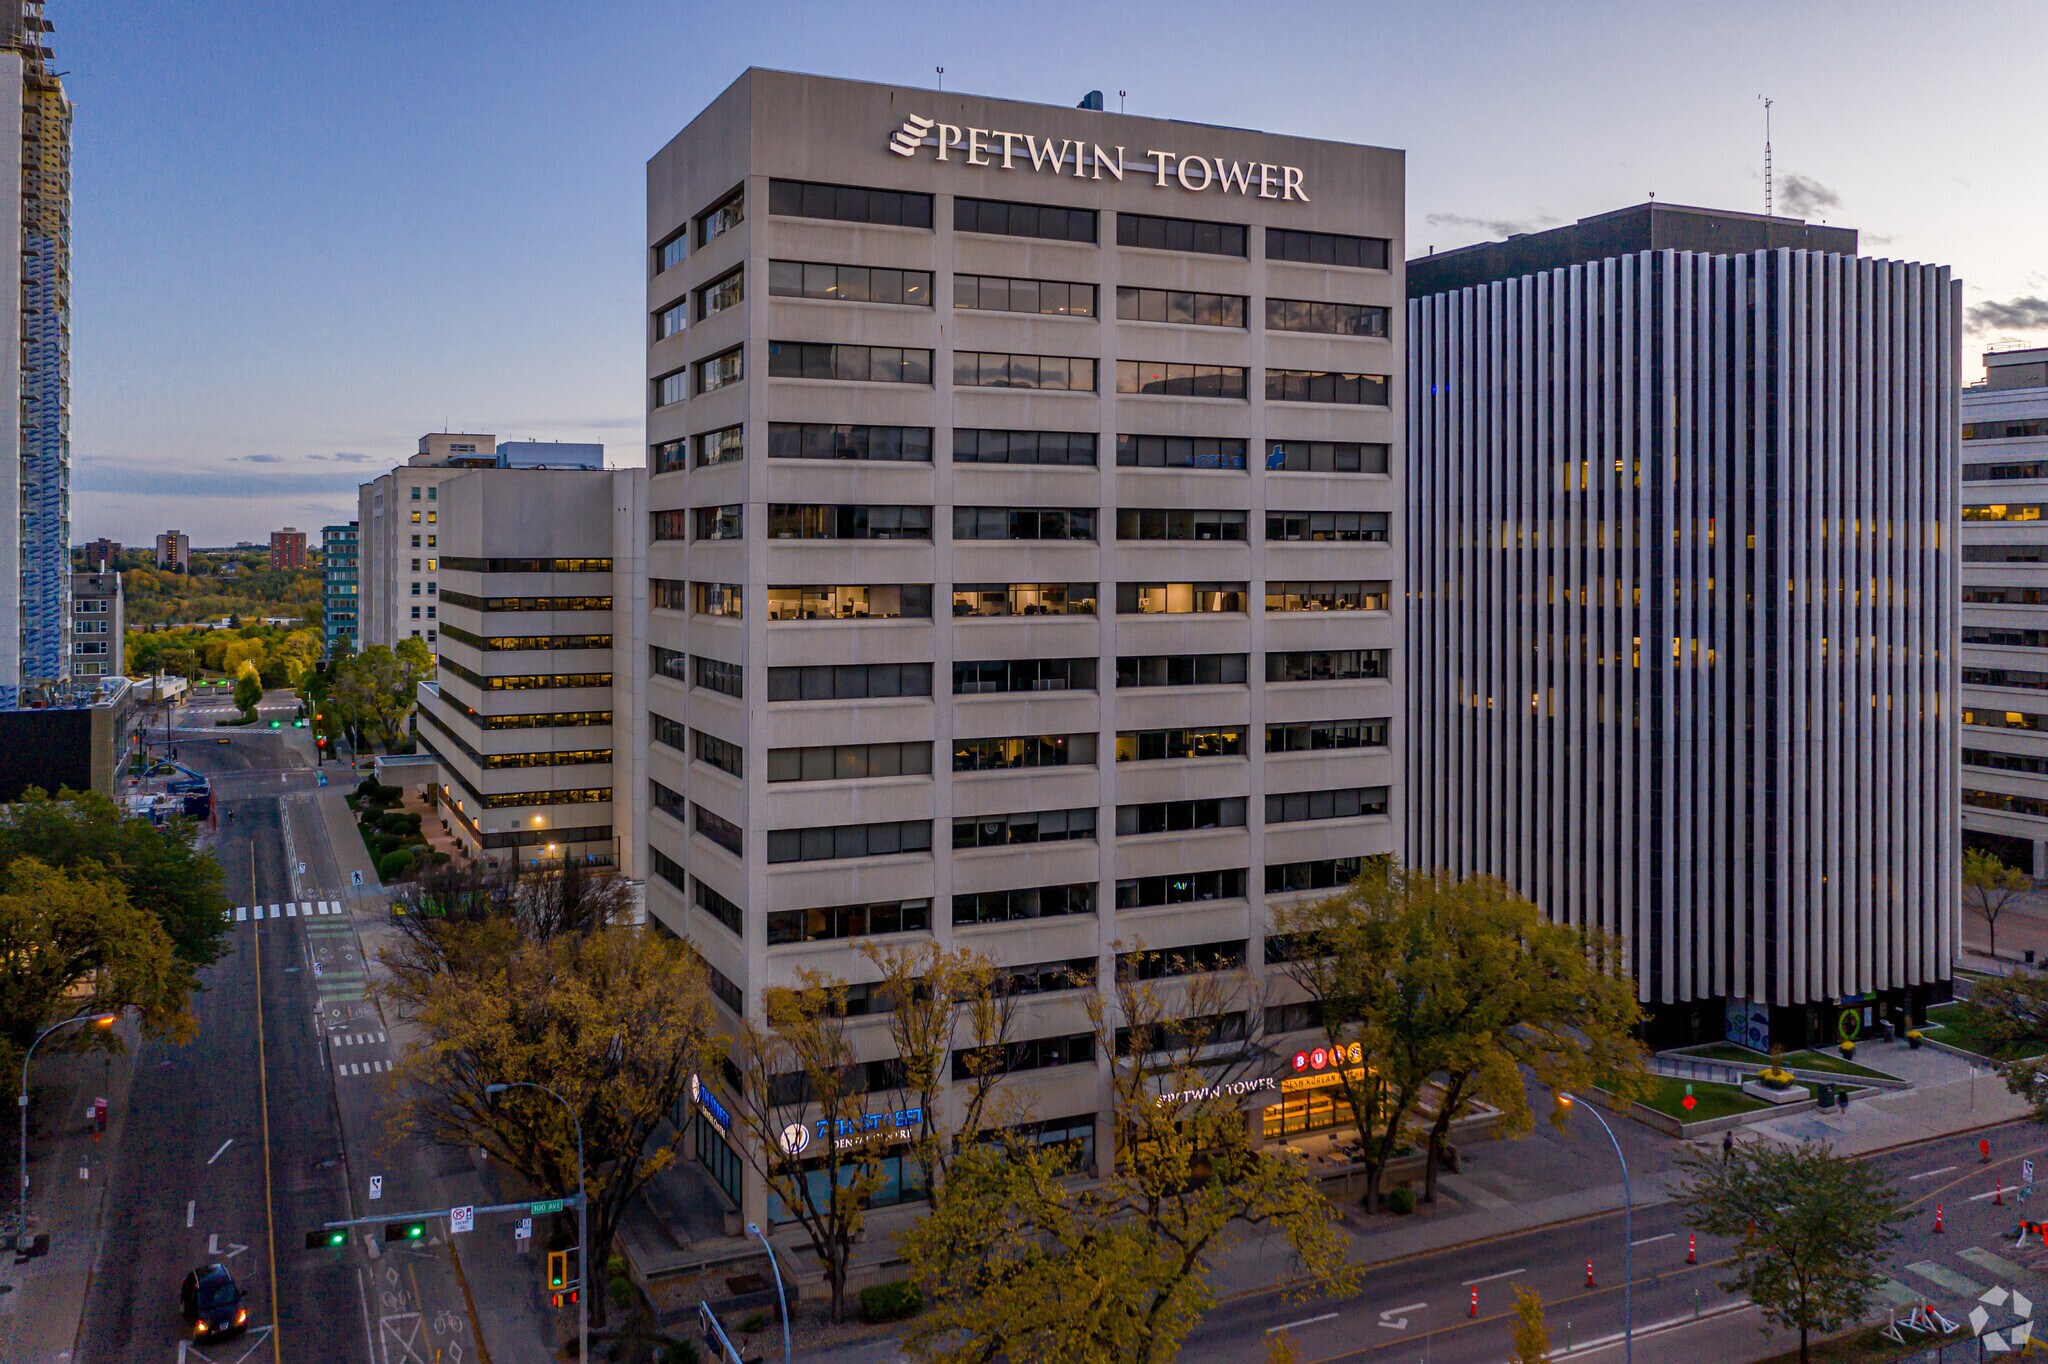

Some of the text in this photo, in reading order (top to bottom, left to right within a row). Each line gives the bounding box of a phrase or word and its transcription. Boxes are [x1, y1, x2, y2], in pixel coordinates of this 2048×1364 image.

[934, 121, 1311, 202] PETWIN TOWER
[1225, 1077, 1276, 1096] TOWER
[815, 1119, 854, 1139] 7TH
[533, 1201, 561, 1212] 100 AVE
